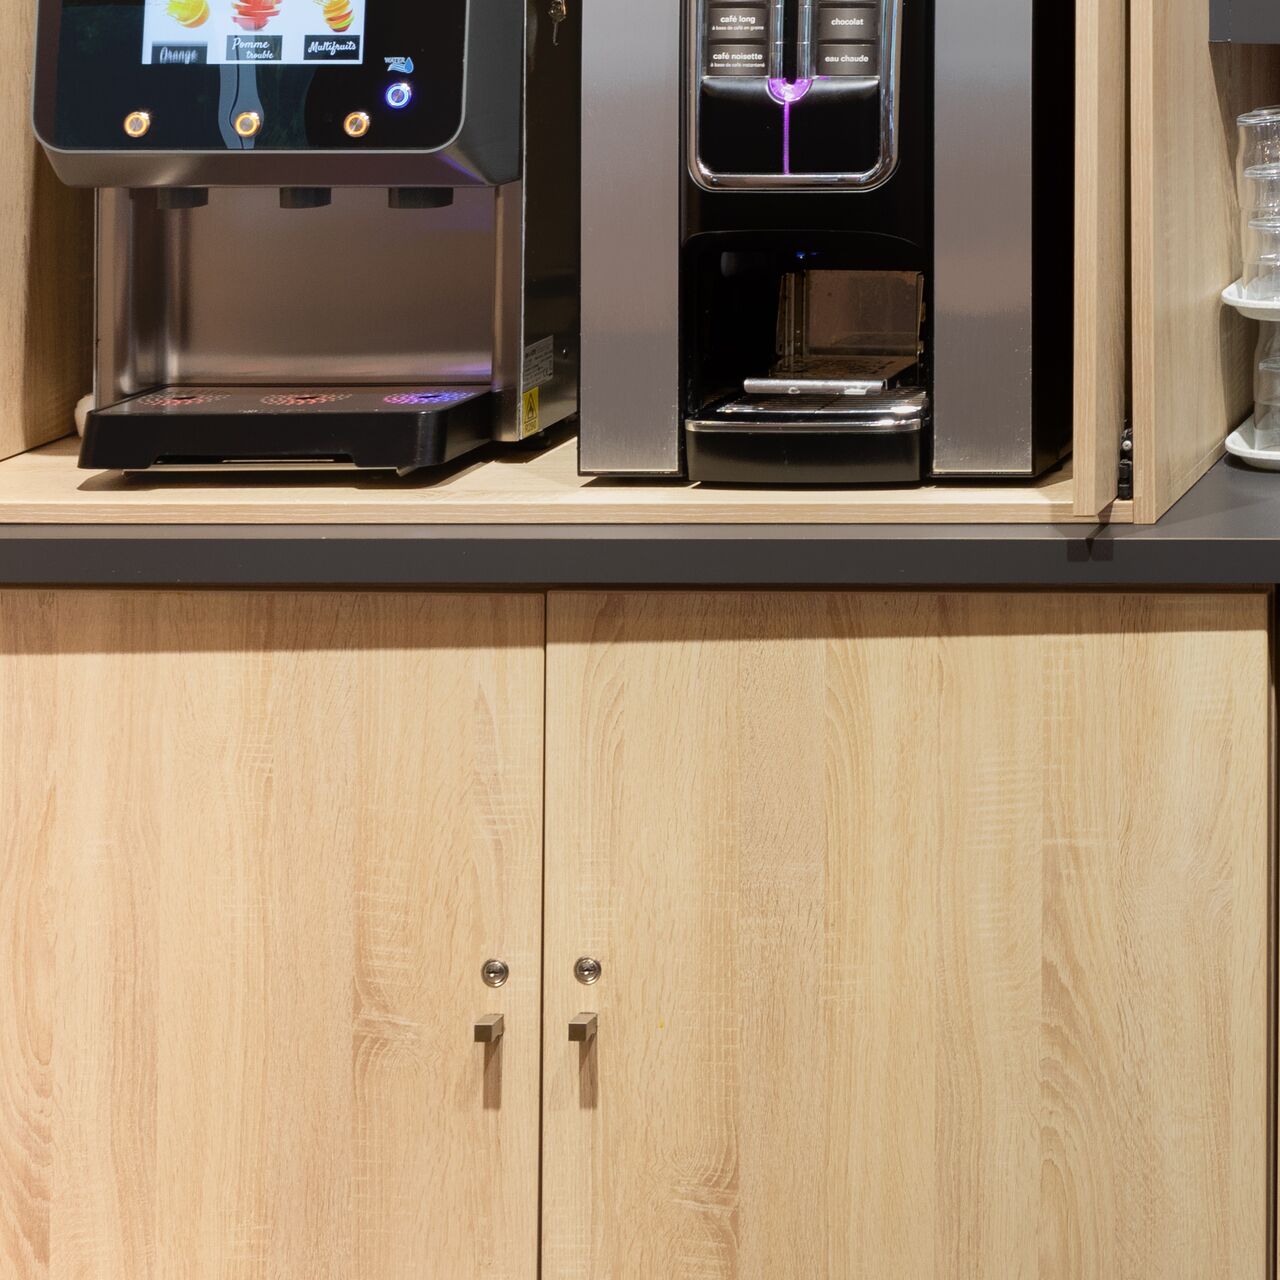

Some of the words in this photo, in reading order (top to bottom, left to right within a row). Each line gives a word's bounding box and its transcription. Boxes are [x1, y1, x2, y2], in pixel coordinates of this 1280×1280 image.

[720, 15, 737, 23] café
[738, 15, 756, 24] long
[831, 17, 864, 25] chocolat
[232, 37, 271, 50] Pomme
[308, 40, 357, 56] Multifruits
[246, 49, 274, 59] trouble
[712, 51, 730, 60] café
[731, 52, 763, 60] noisette
[840, 54, 869, 62] chaude
